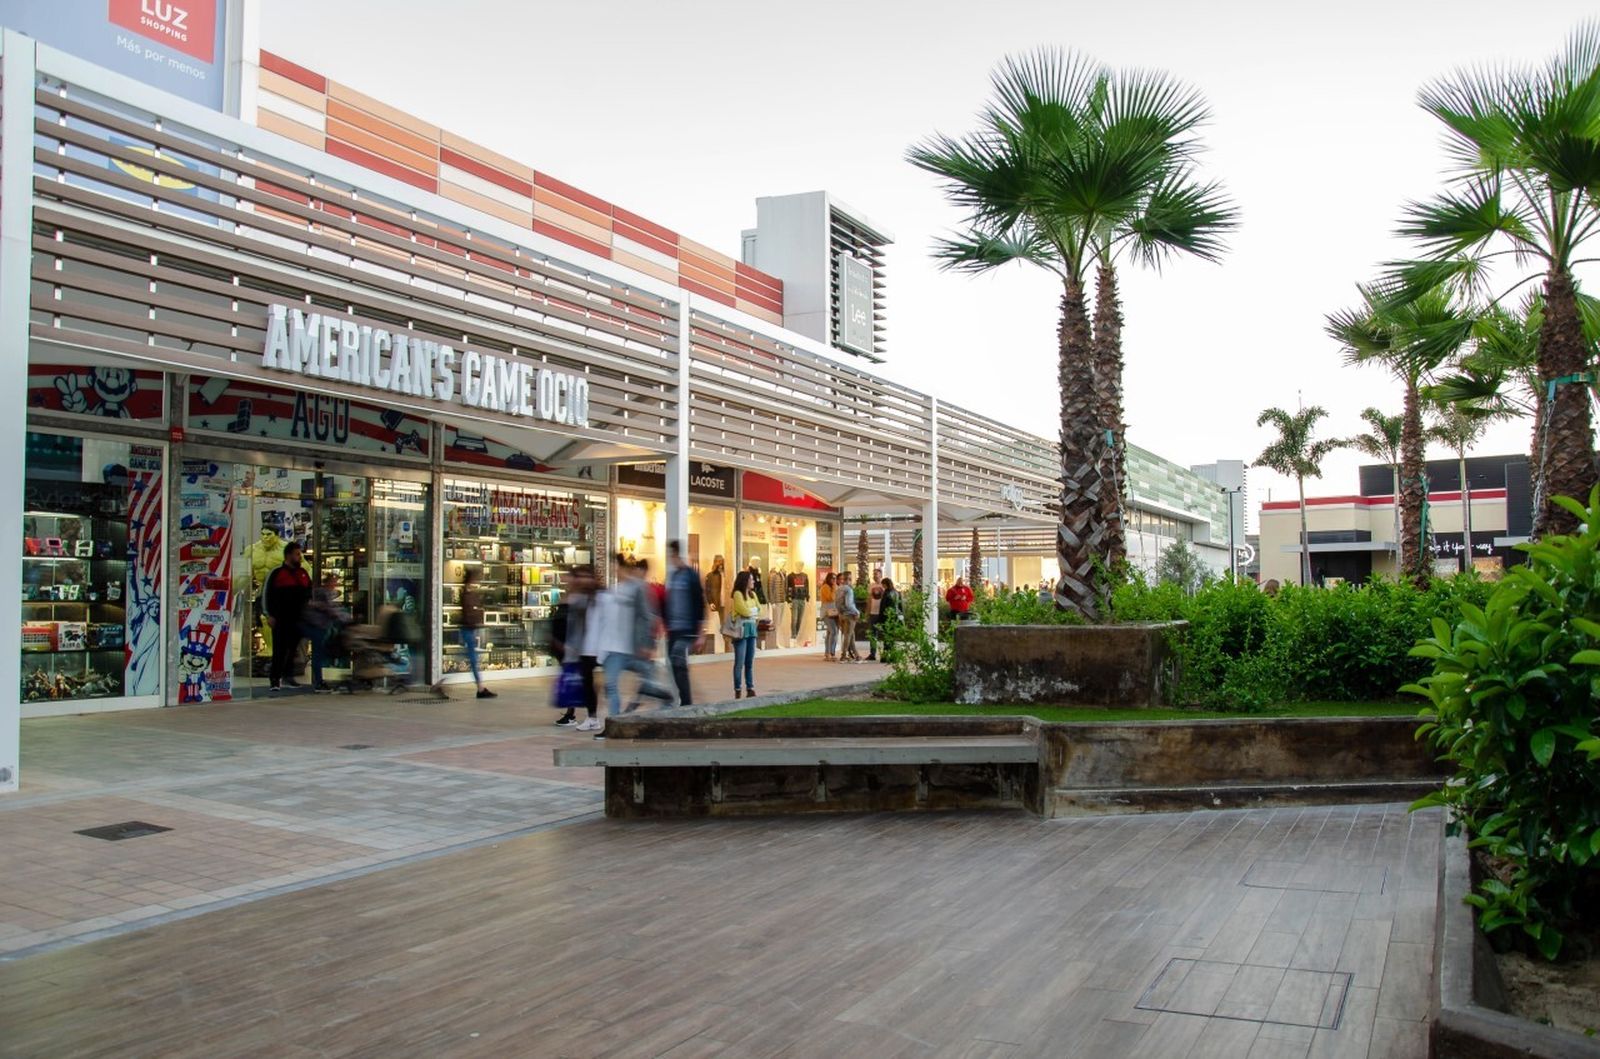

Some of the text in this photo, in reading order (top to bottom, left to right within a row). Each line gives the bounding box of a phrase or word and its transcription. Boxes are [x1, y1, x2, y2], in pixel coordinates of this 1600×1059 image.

[140, 16, 188, 42] SHOPPING
[141, 0, 188, 30] LUZ
[116, 35, 206, 80] Más por menos
[851, 303, 867, 327] Lee
[262, 303, 589, 428] AMERICAN'S GAME OCIO
[690, 475, 726, 490] LACOSTE
